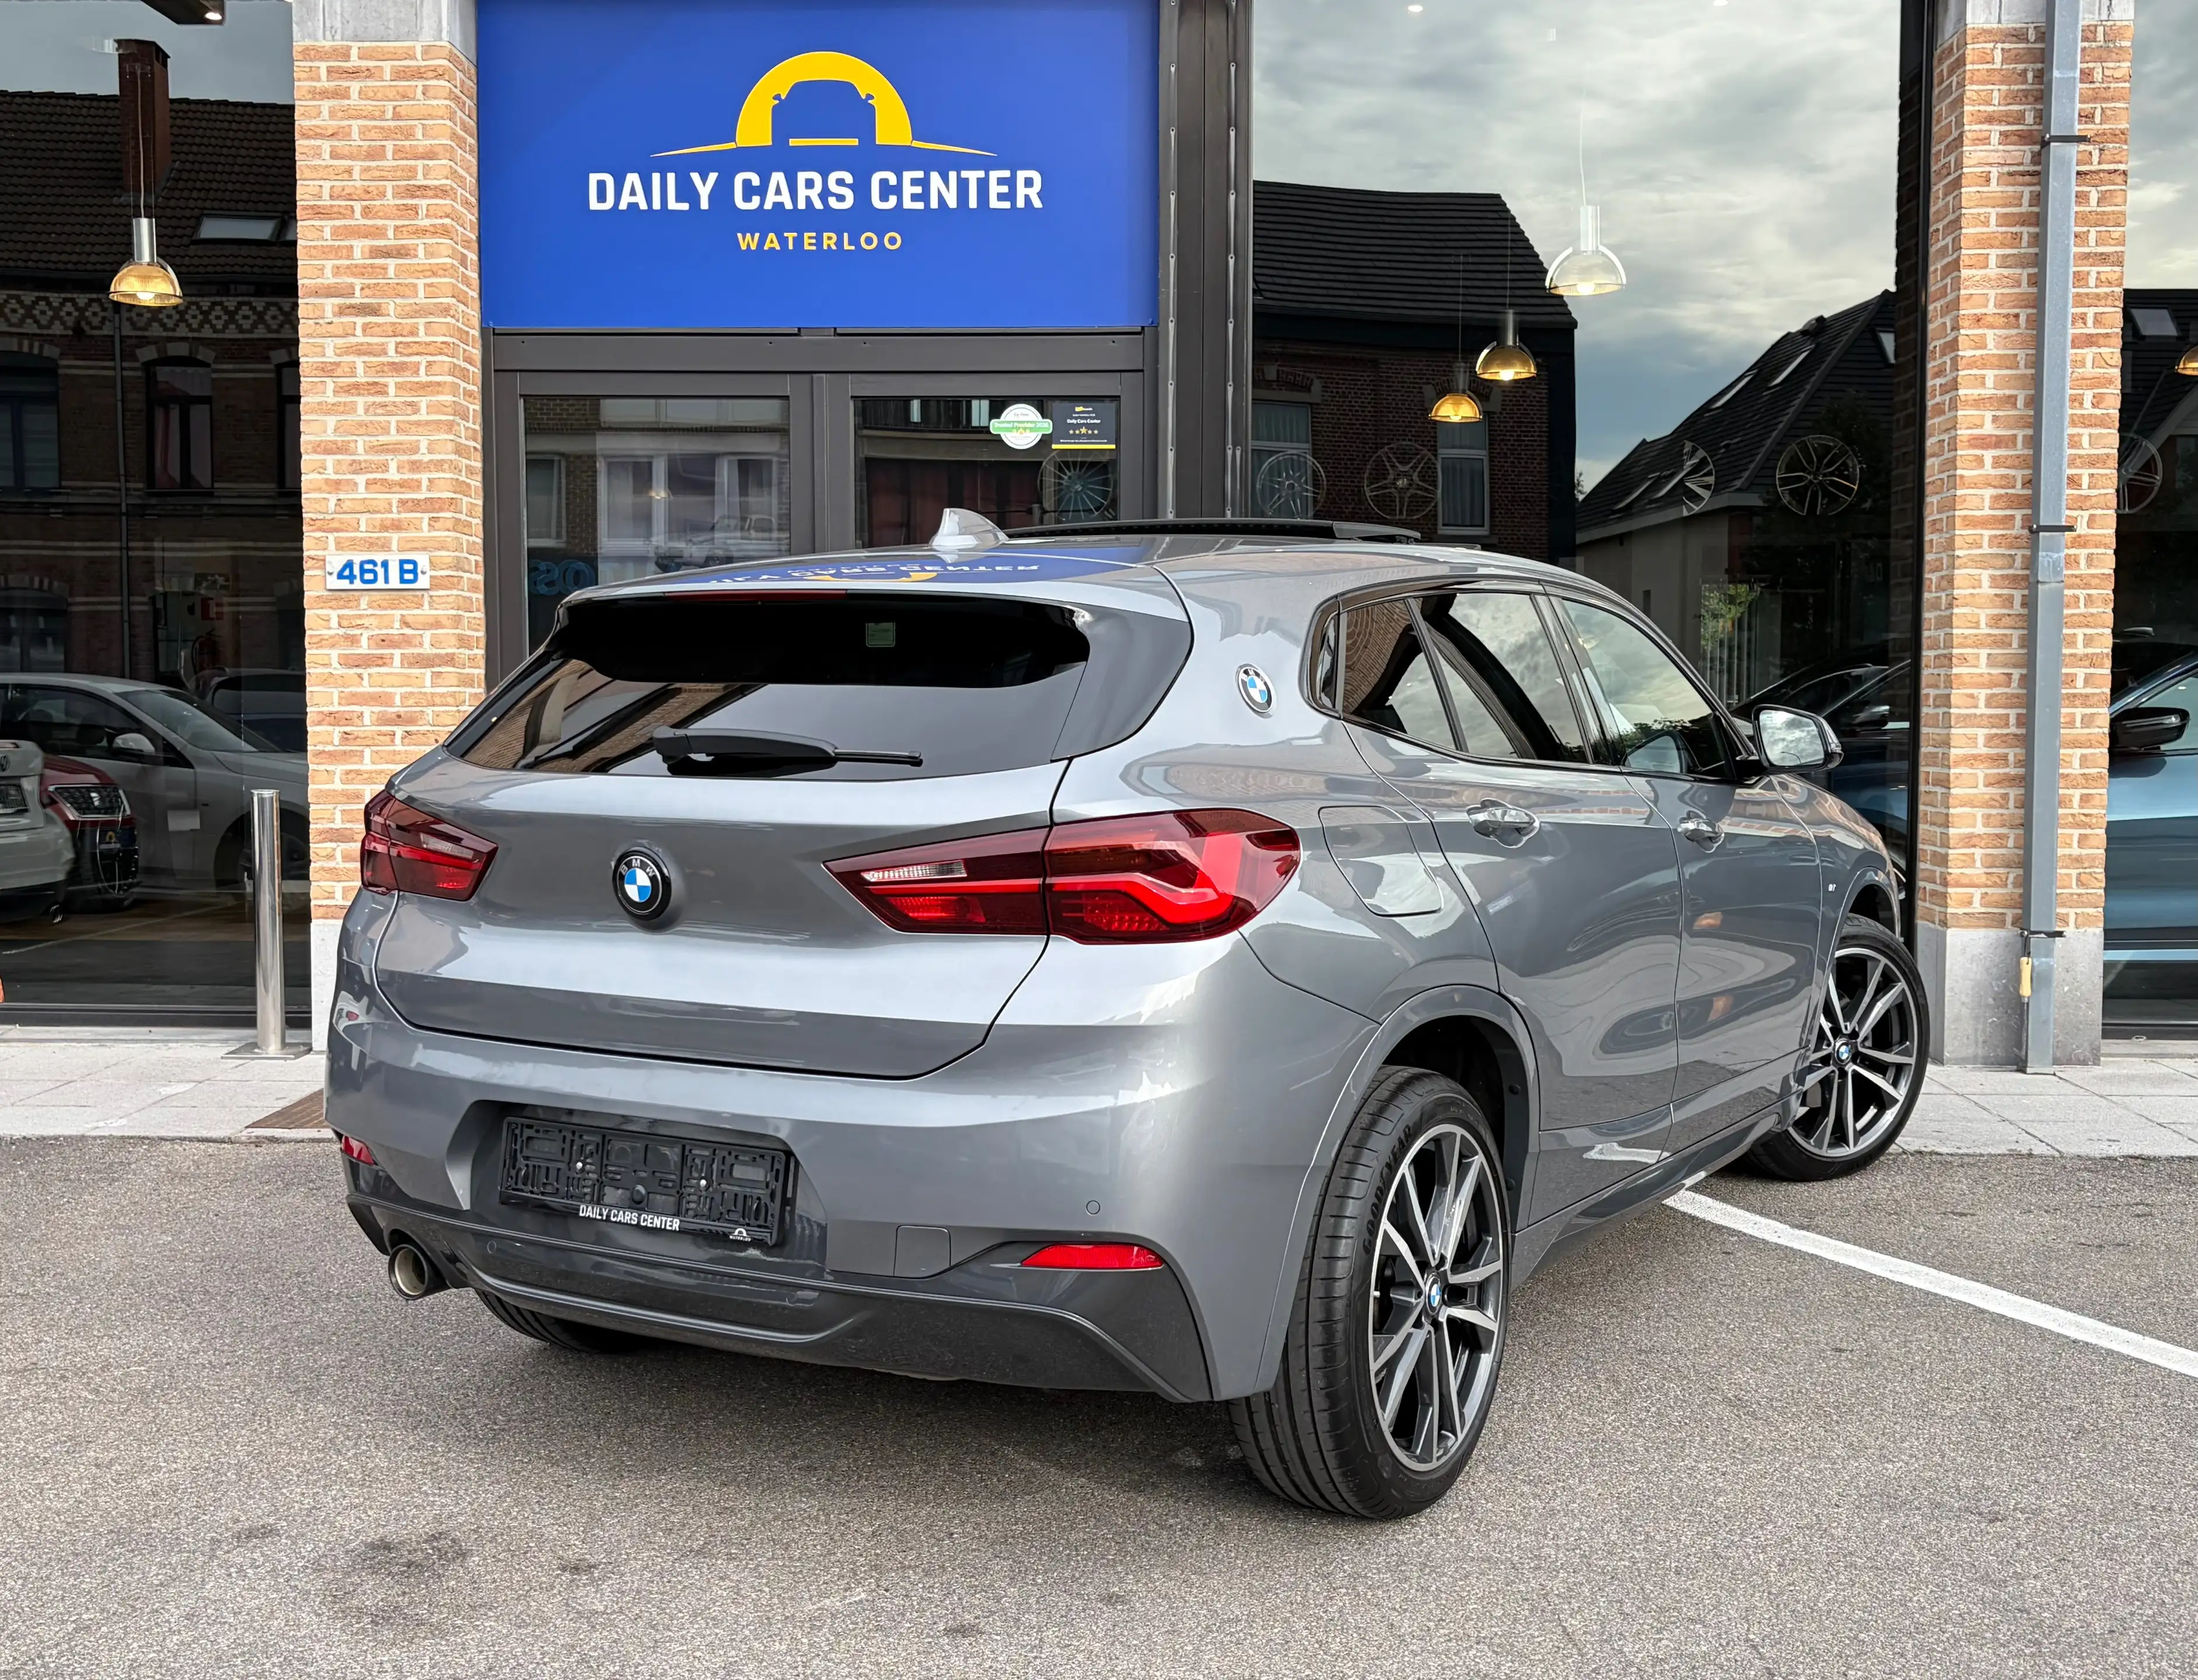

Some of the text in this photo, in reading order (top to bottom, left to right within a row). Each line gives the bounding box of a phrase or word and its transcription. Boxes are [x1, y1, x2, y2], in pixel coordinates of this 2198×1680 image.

[588, 170, 1044, 211] DAILY CARS CENTER
[737, 232, 902, 251] WATERLOO
[337, 559, 419, 584] 461 B
[620, 858, 657, 877] BMW
[1363, 1124, 1412, 1255] GOODYEAR
[579, 1204, 680, 1231] DAILY CARS CENTER
